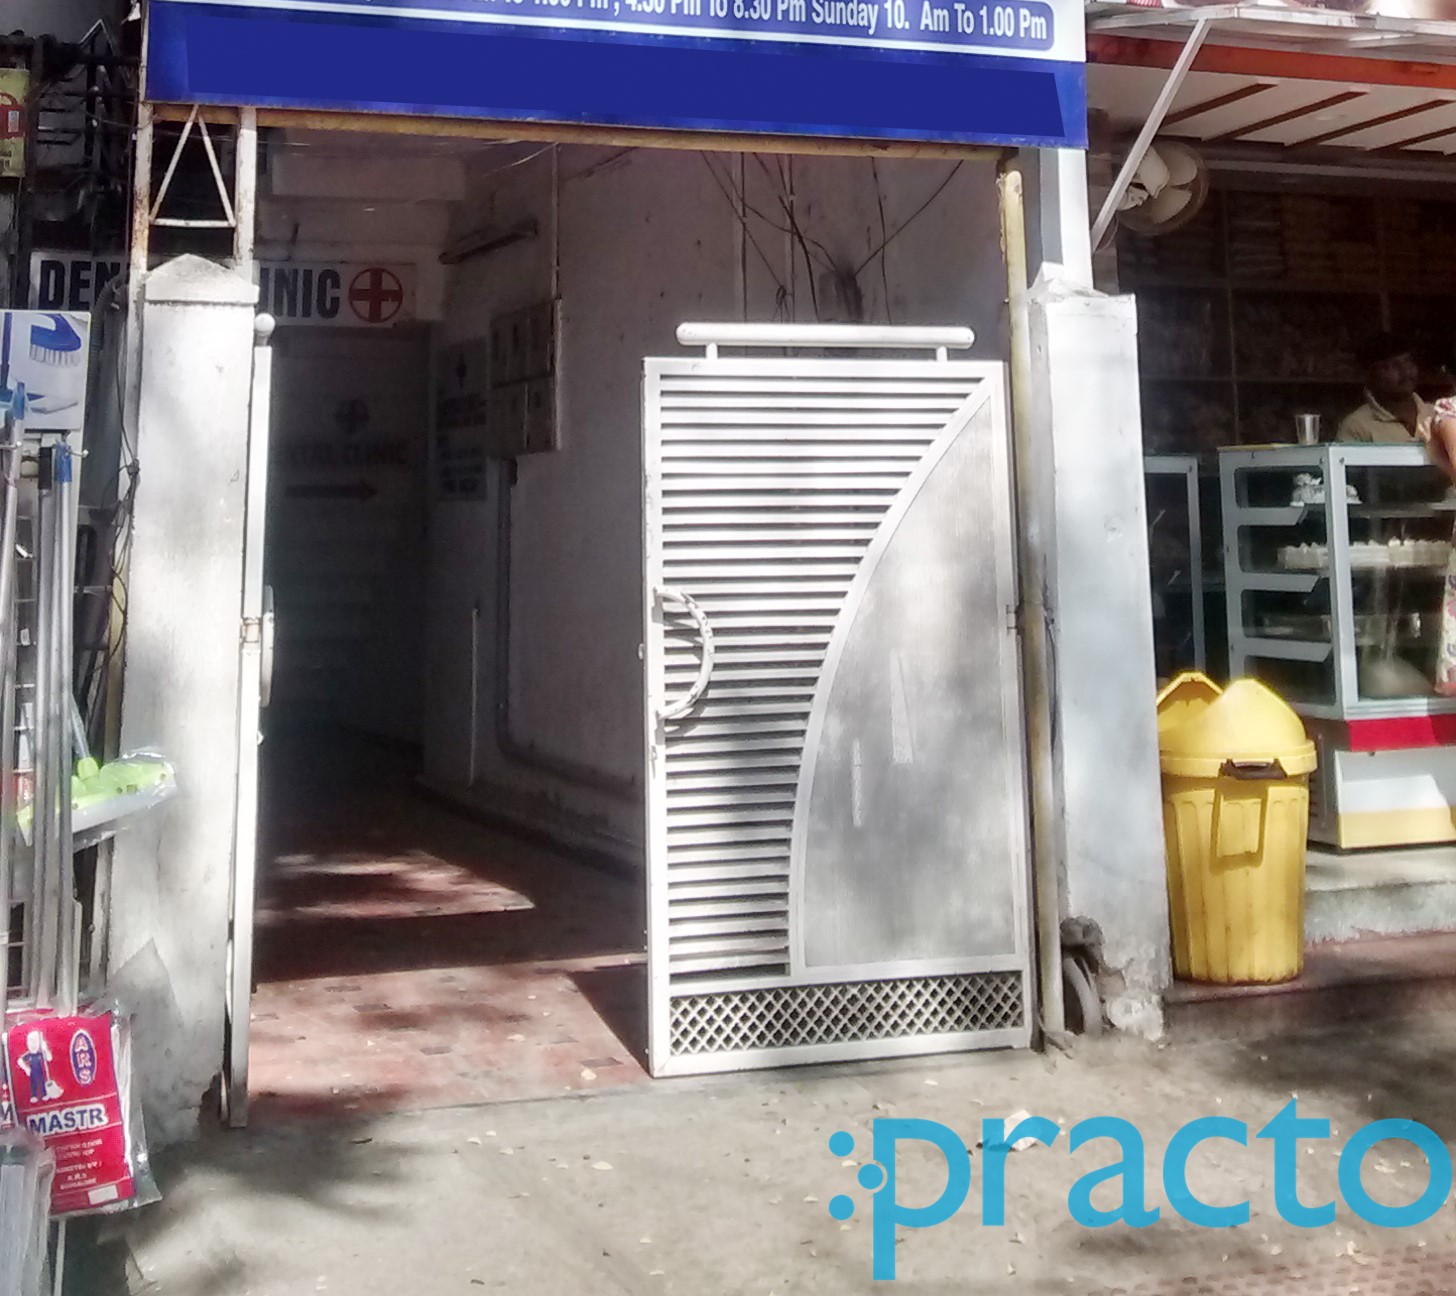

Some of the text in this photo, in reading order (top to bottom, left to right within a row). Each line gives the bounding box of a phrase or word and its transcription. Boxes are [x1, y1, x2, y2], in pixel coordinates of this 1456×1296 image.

[920, 0, 949, 31] Am
[954, 3, 974, 34] To
[980, 6, 1015, 37] 1.00
[1019, 9, 1047, 40] Pm
[258, 268, 341, 319] INIC
[29, 1108, 105, 1134] MASTR
